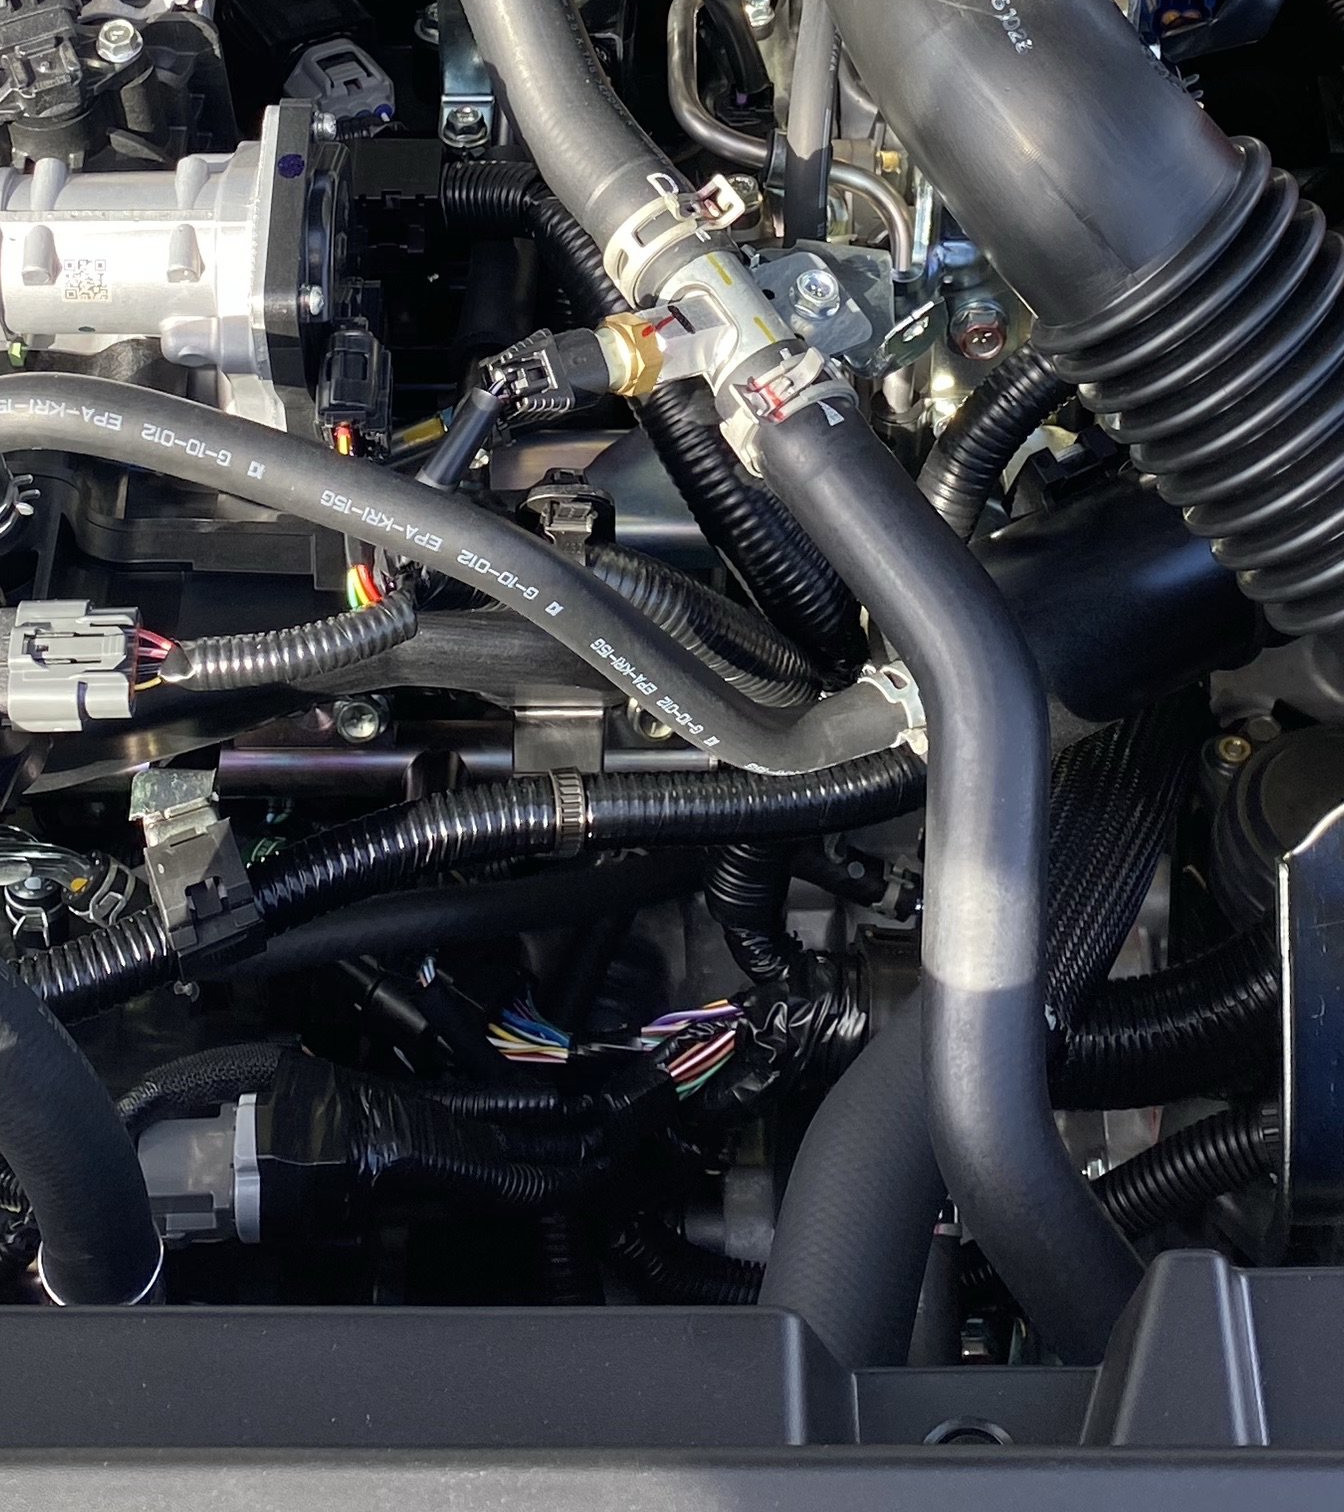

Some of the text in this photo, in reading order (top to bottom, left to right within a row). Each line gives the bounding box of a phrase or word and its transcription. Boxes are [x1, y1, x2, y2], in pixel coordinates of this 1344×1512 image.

[141, 422, 233, 468] G-10-012
[457, 548, 540, 601] G-10-012
[656, 695, 705, 736] G-10-012
